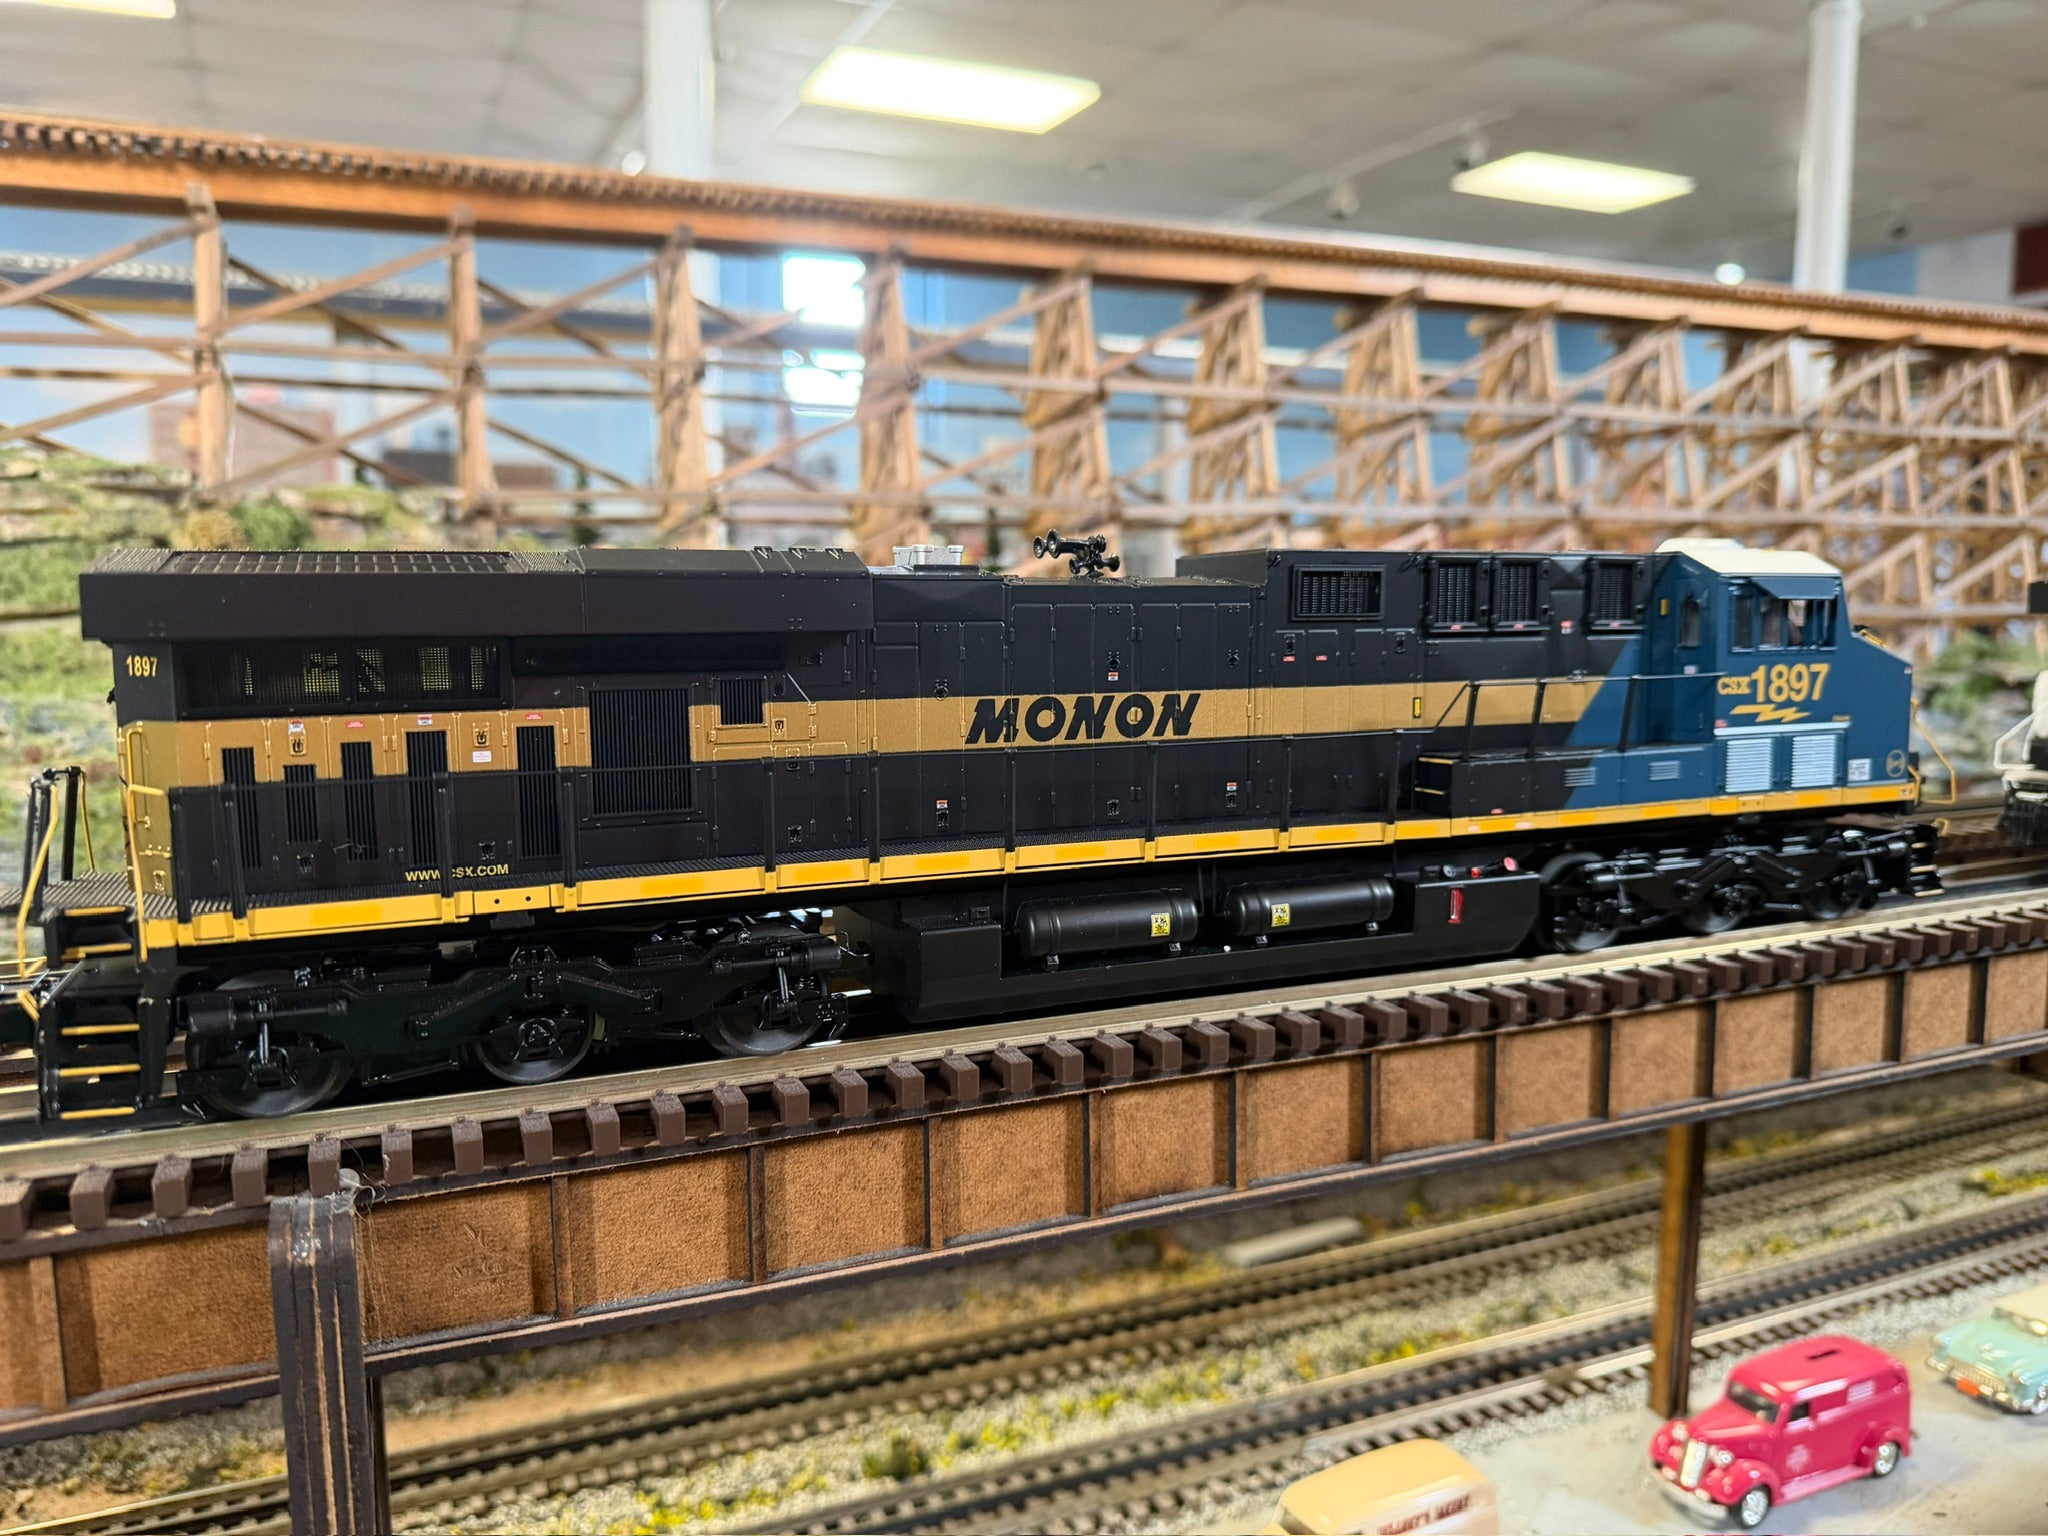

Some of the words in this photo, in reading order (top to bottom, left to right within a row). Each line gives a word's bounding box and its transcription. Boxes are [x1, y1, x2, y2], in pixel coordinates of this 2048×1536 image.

[126, 655, 158, 678] 1897
[1751, 663, 1829, 703] 1897
[965, 693, 1201, 744] MONON
[405, 863, 509, 882] WWWSX.COM
